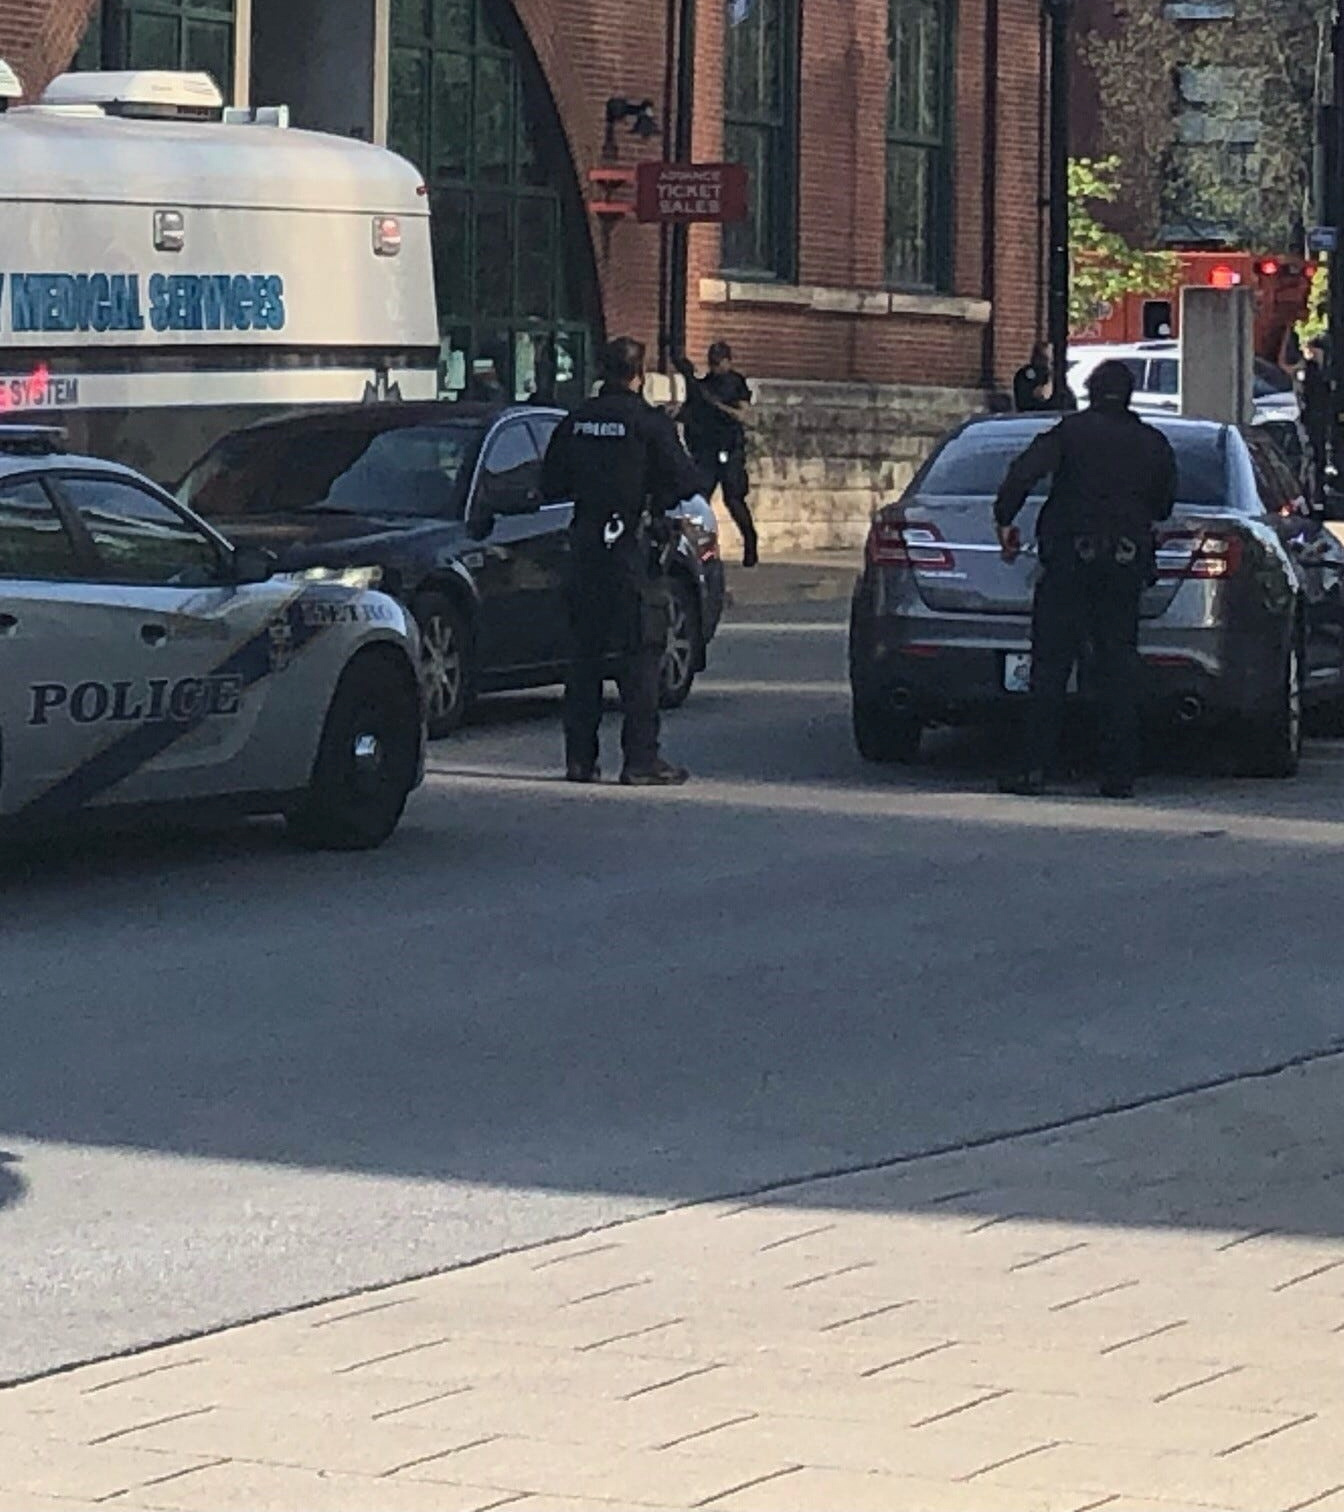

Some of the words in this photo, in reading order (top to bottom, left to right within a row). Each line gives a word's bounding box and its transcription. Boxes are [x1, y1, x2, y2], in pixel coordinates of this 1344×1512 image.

[656, 184, 722, 200] TICKET
[659, 200, 720, 214] SALES
[10, 272, 145, 332] MEDICAL
[149, 273, 286, 332] SERVICES
[10, 378, 79, 405] SYSTEM
[27, 675, 242, 726] POLICE
